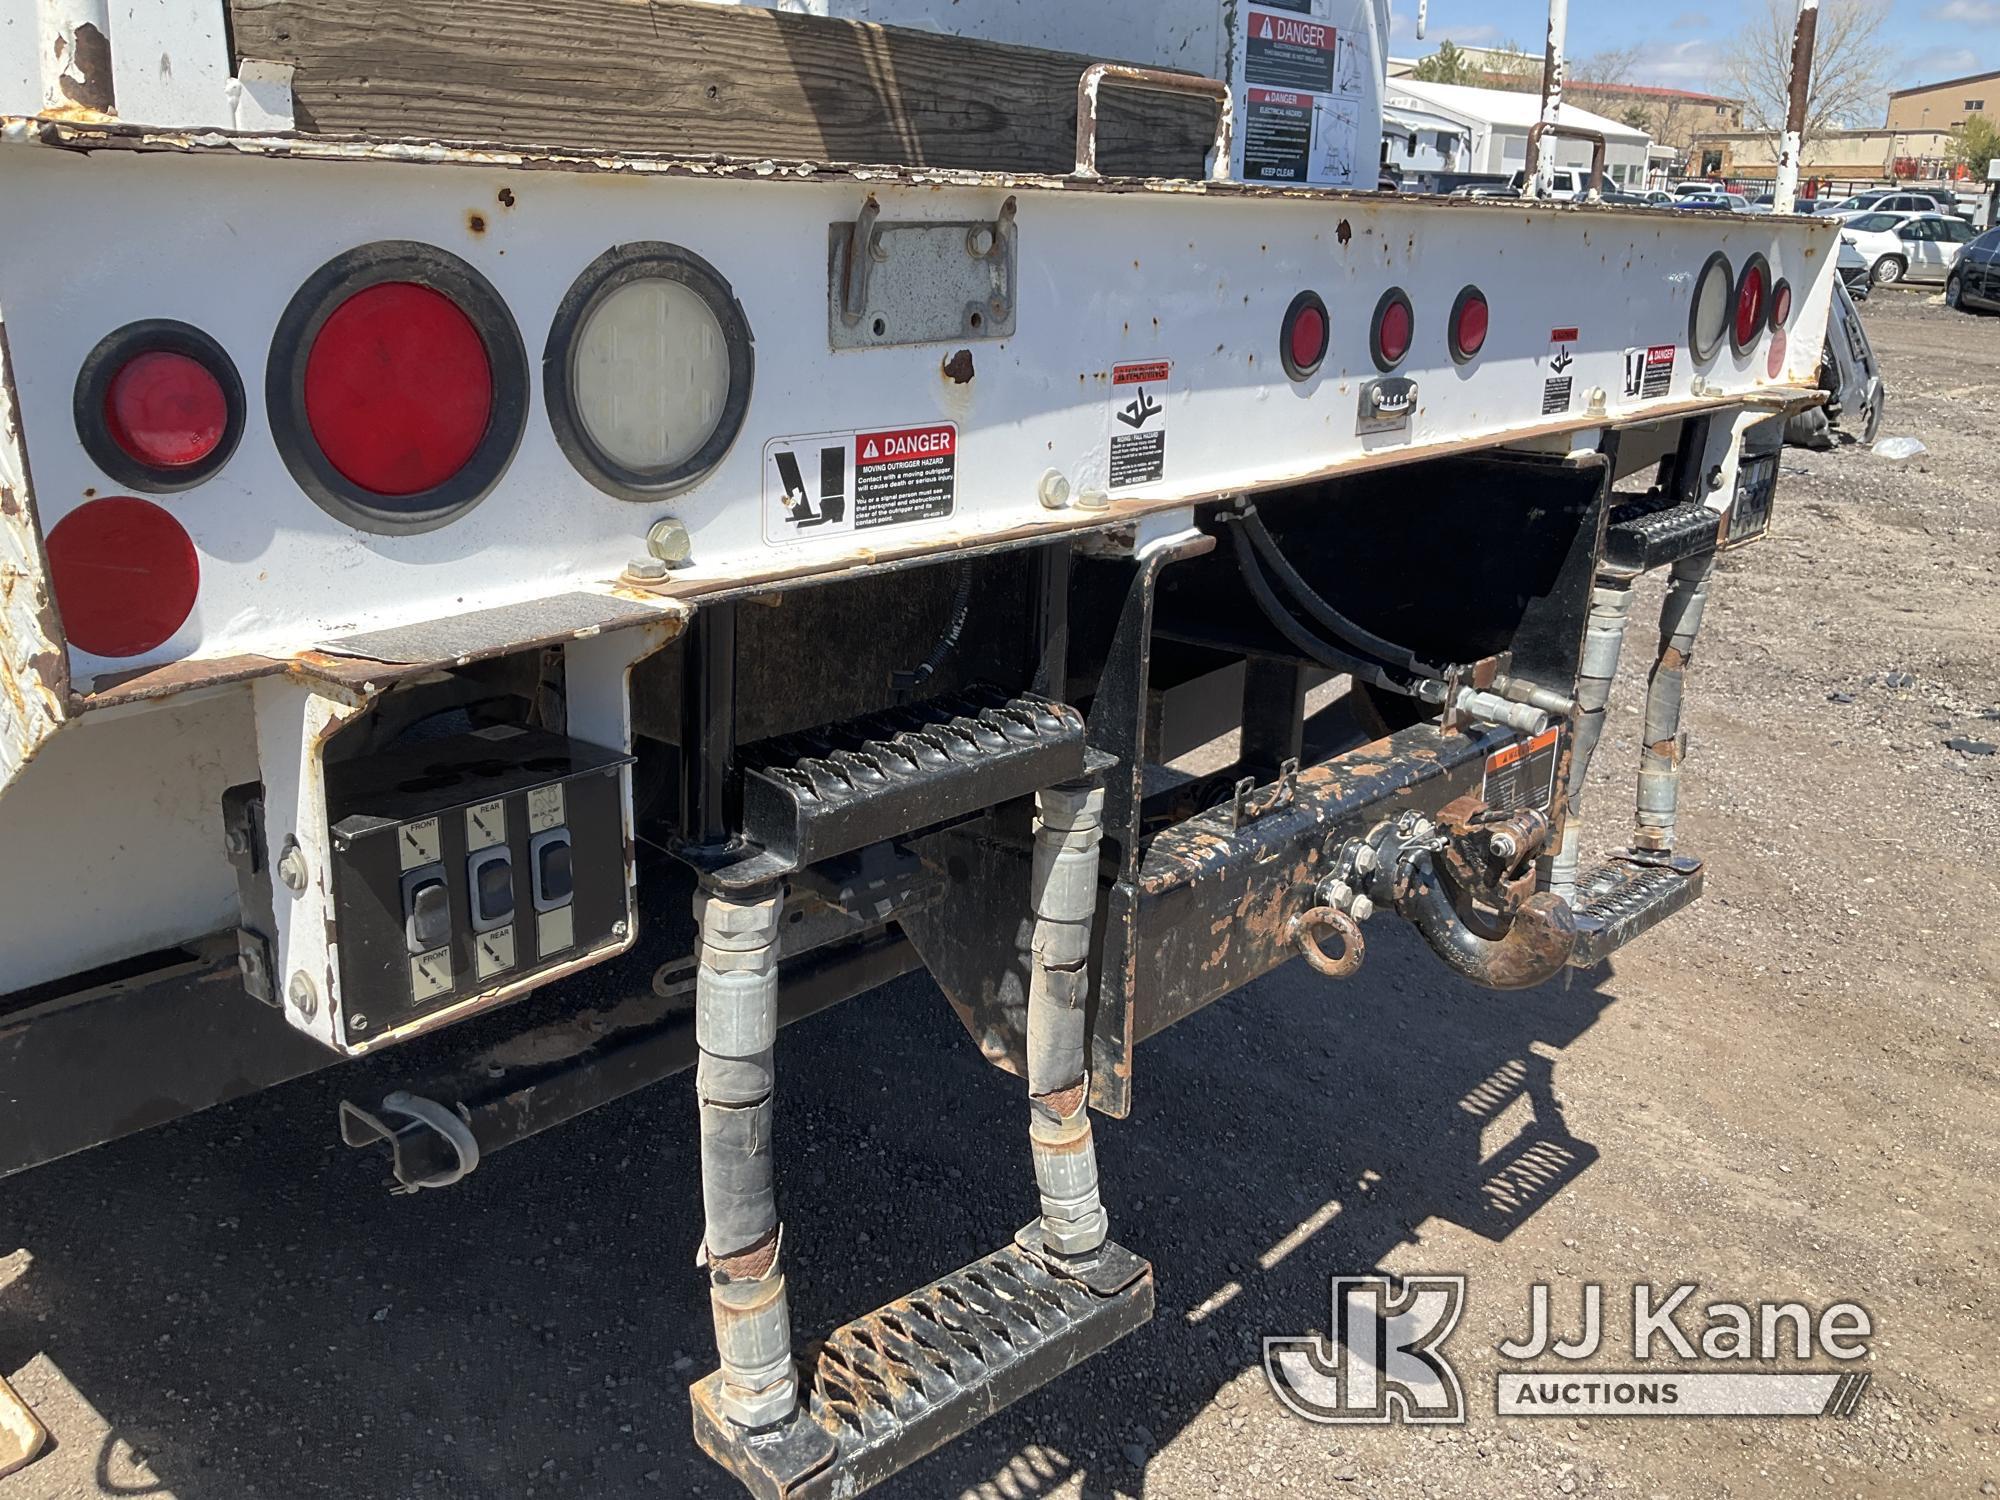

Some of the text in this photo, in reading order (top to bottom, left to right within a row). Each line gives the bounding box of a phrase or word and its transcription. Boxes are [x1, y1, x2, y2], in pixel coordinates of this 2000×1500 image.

[1277, 20, 1324, 47] DANGER
[1271, 92, 1297, 104] DANGER
[1260, 107, 1285, 116] ELECTRICAL
[1261, 168, 1294, 177] KEEP CLEAR
[1654, 349, 1673, 360] DANGER
[884, 432, 950, 456] DANGER
[863, 458, 944, 473] MOVING OUTRIGGER HAZARD
[858, 475, 882, 484] Contact
[925, 467, 951, 476] outrigger
[890, 480, 907, 488] death
[899, 492, 917, 500] person
[869, 502, 896, 510] personnel
[909, 495, 941, 504] obstructions
[889, 506, 913, 514] outrigger
[856, 518, 877, 526] contact
[480, 803, 500, 813] REAR
[410, 819, 437, 832] FRONT
[490, 929, 509, 940] REAR
[423, 949, 448, 963] FRONT
